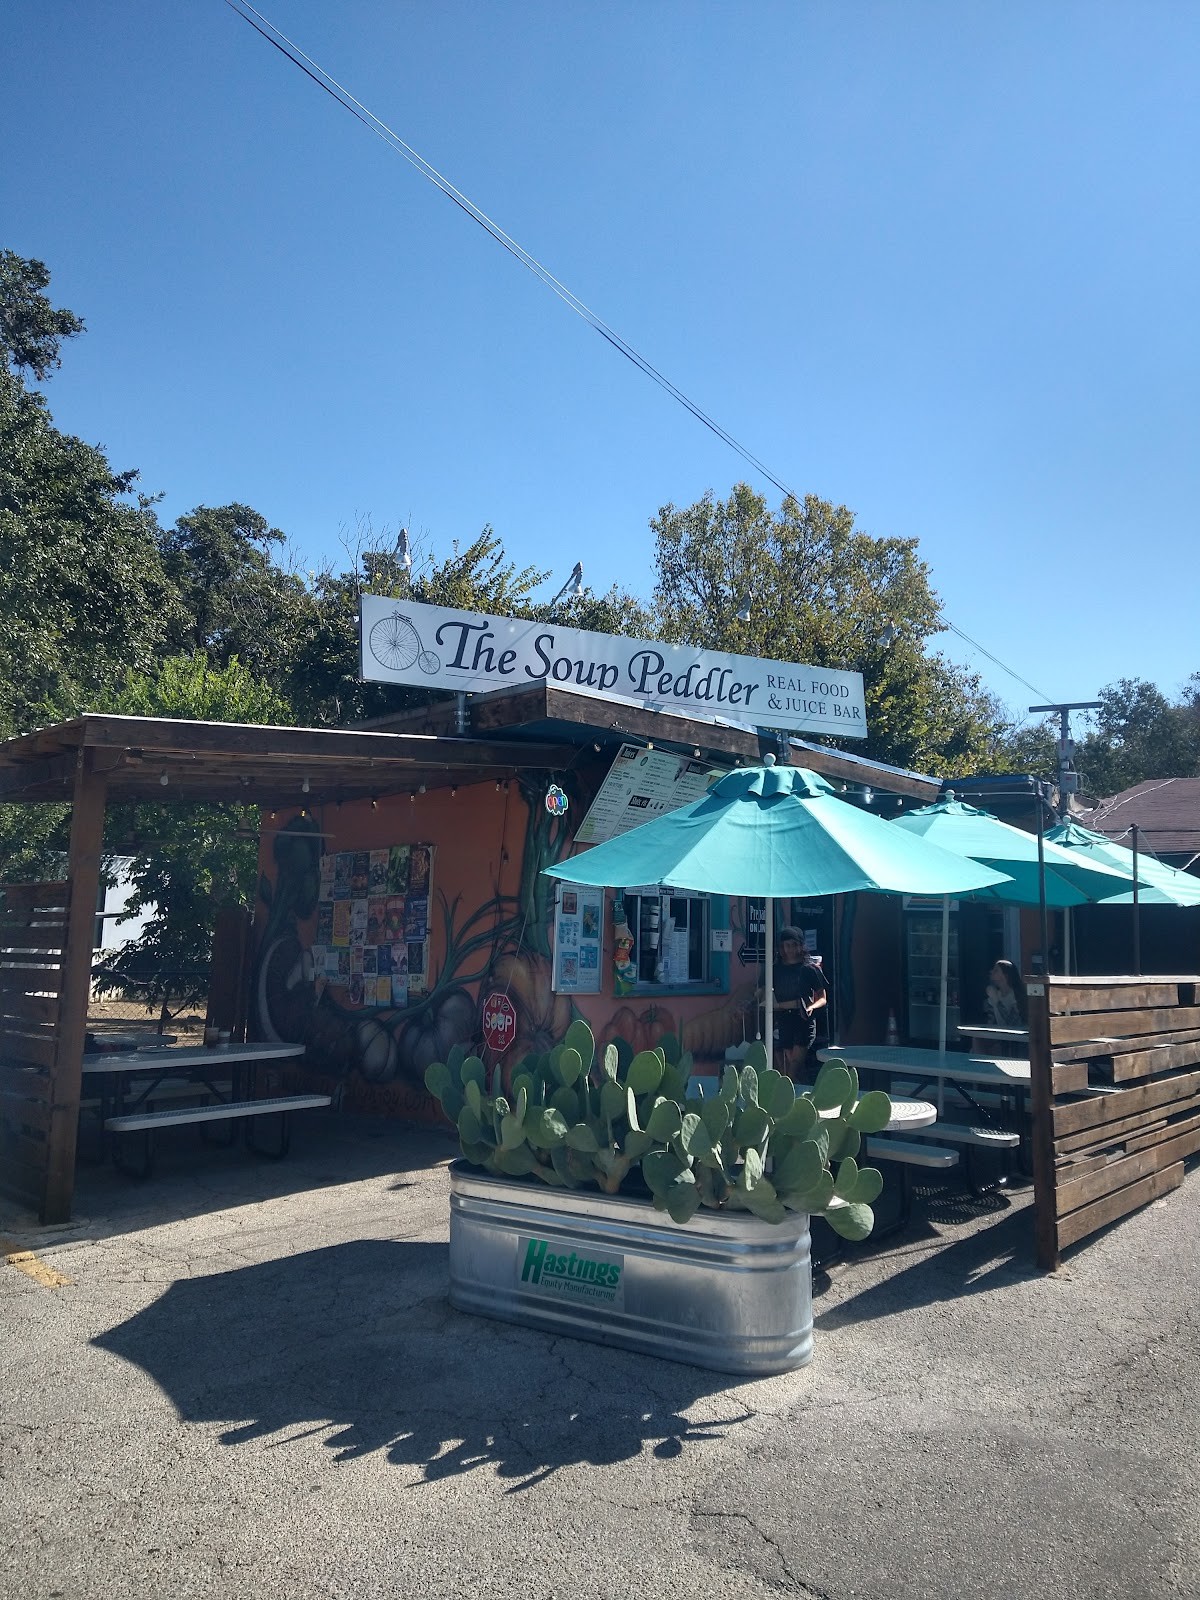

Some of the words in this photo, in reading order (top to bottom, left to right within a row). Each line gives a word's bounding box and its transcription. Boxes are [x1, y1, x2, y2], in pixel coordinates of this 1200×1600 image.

[436, 621, 517, 675] The
[525, 634, 619, 691] Soup
[628, 650, 760, 706] Peddler
[767, 675, 806, 693] REAL
[811, 681, 849, 698] FOOD
[768, 693, 783, 710] &
[786, 698, 827, 715] JUICE
[834, 704, 861, 719] BAR
[749, 923, 766, 933] ONLIN
[485, 1011, 513, 1032] SOUP
[521, 1238, 621, 1286] Hastings
[540, 1276, 563, 1291] Equity
[563, 1281, 616, 1302] Manufacturing
